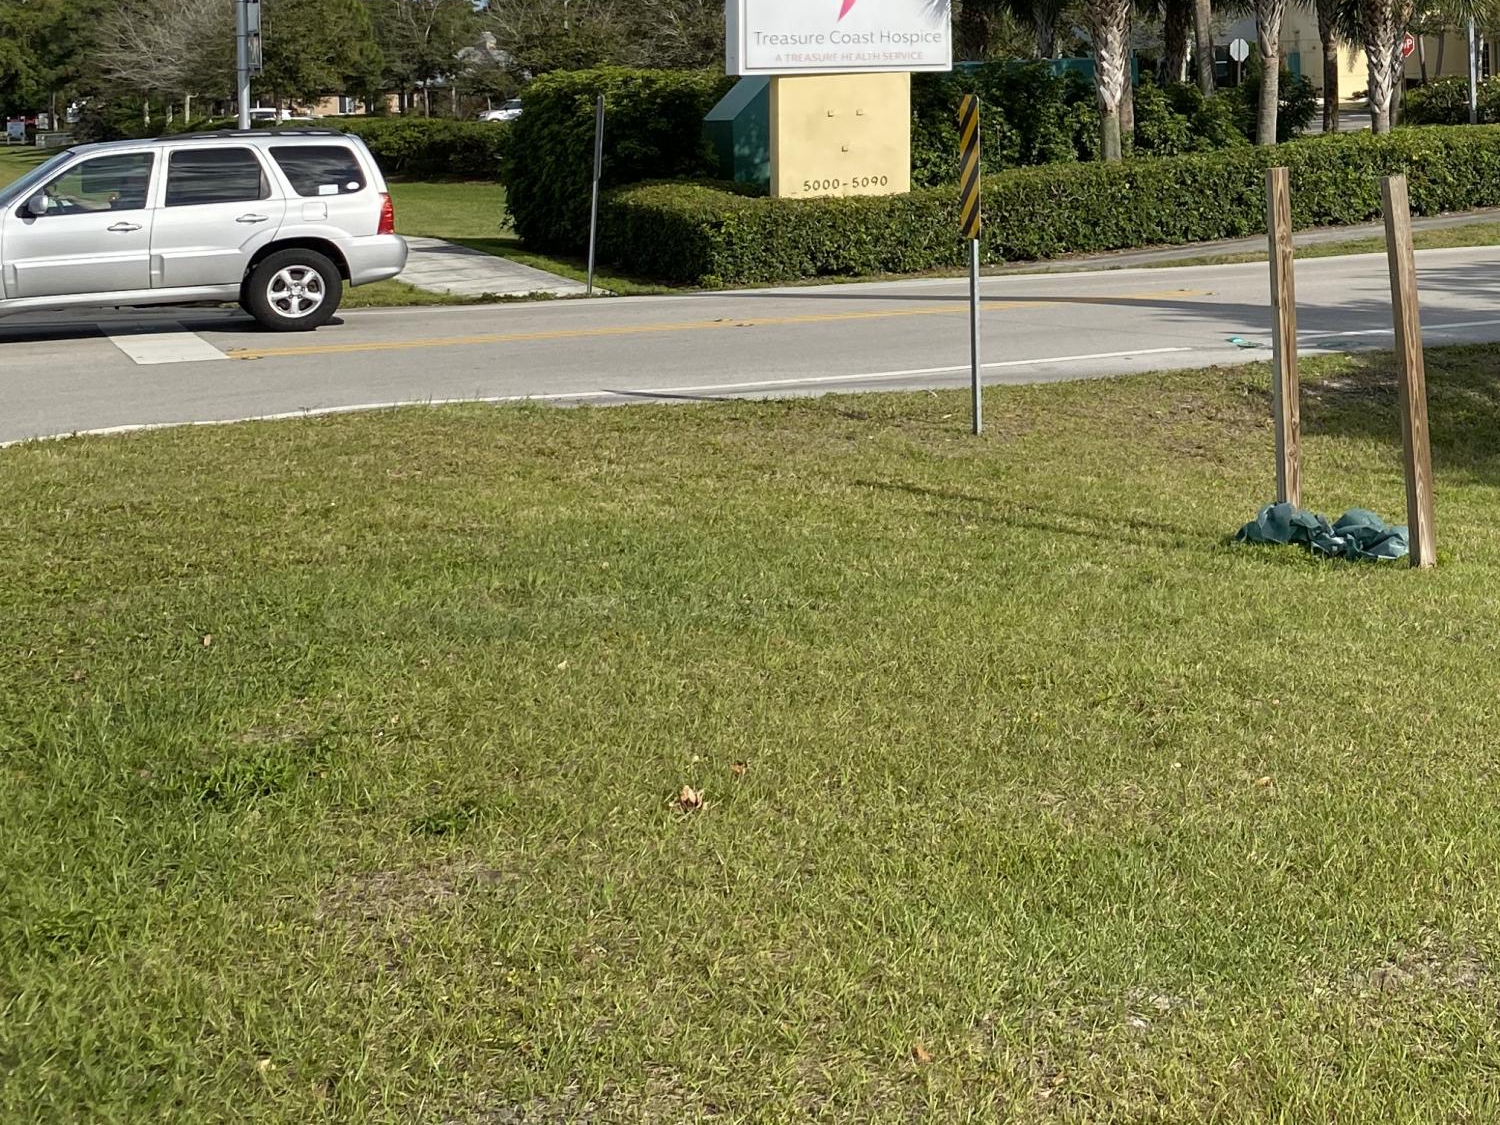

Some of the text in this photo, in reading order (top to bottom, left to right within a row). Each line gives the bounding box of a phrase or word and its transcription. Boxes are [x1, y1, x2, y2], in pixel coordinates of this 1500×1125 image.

[754, 30, 941, 46] Treasure Coast Hospice
[775, 51, 923, 63] A TREASURE HEALTH SERVICE
